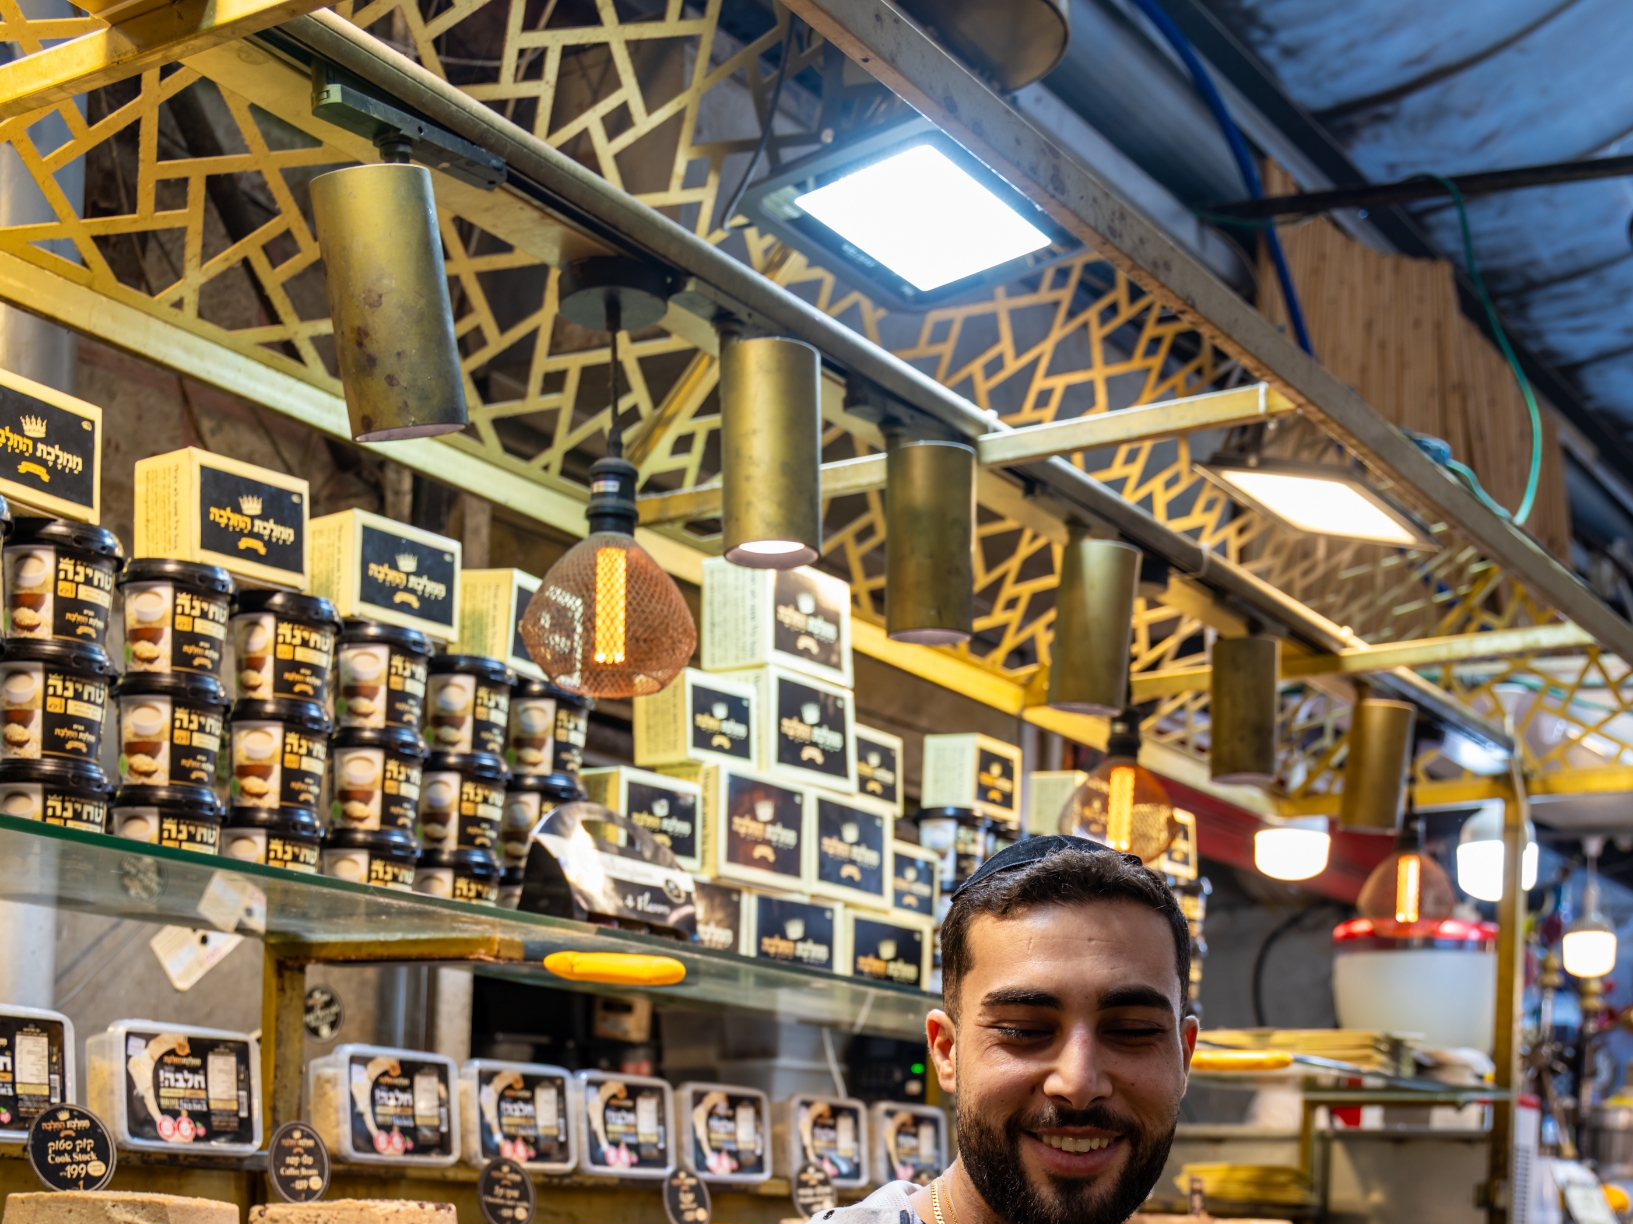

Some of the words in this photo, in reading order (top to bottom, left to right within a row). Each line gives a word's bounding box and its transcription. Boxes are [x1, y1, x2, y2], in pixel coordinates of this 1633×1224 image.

[58, 562, 112, 591] טחינה
[176, 597, 228, 624] טחינה
[276, 627, 332, 652] טחינה
[48, 678, 104, 705] טחינה
[46, 800, 104, 823] טחינה
[162, 823, 216, 844] טחינה
[47, 1153, 72, 1164] Cook
[72, 1151, 97, 1162] Stock
[65, 1163, 87, 1179] 199
